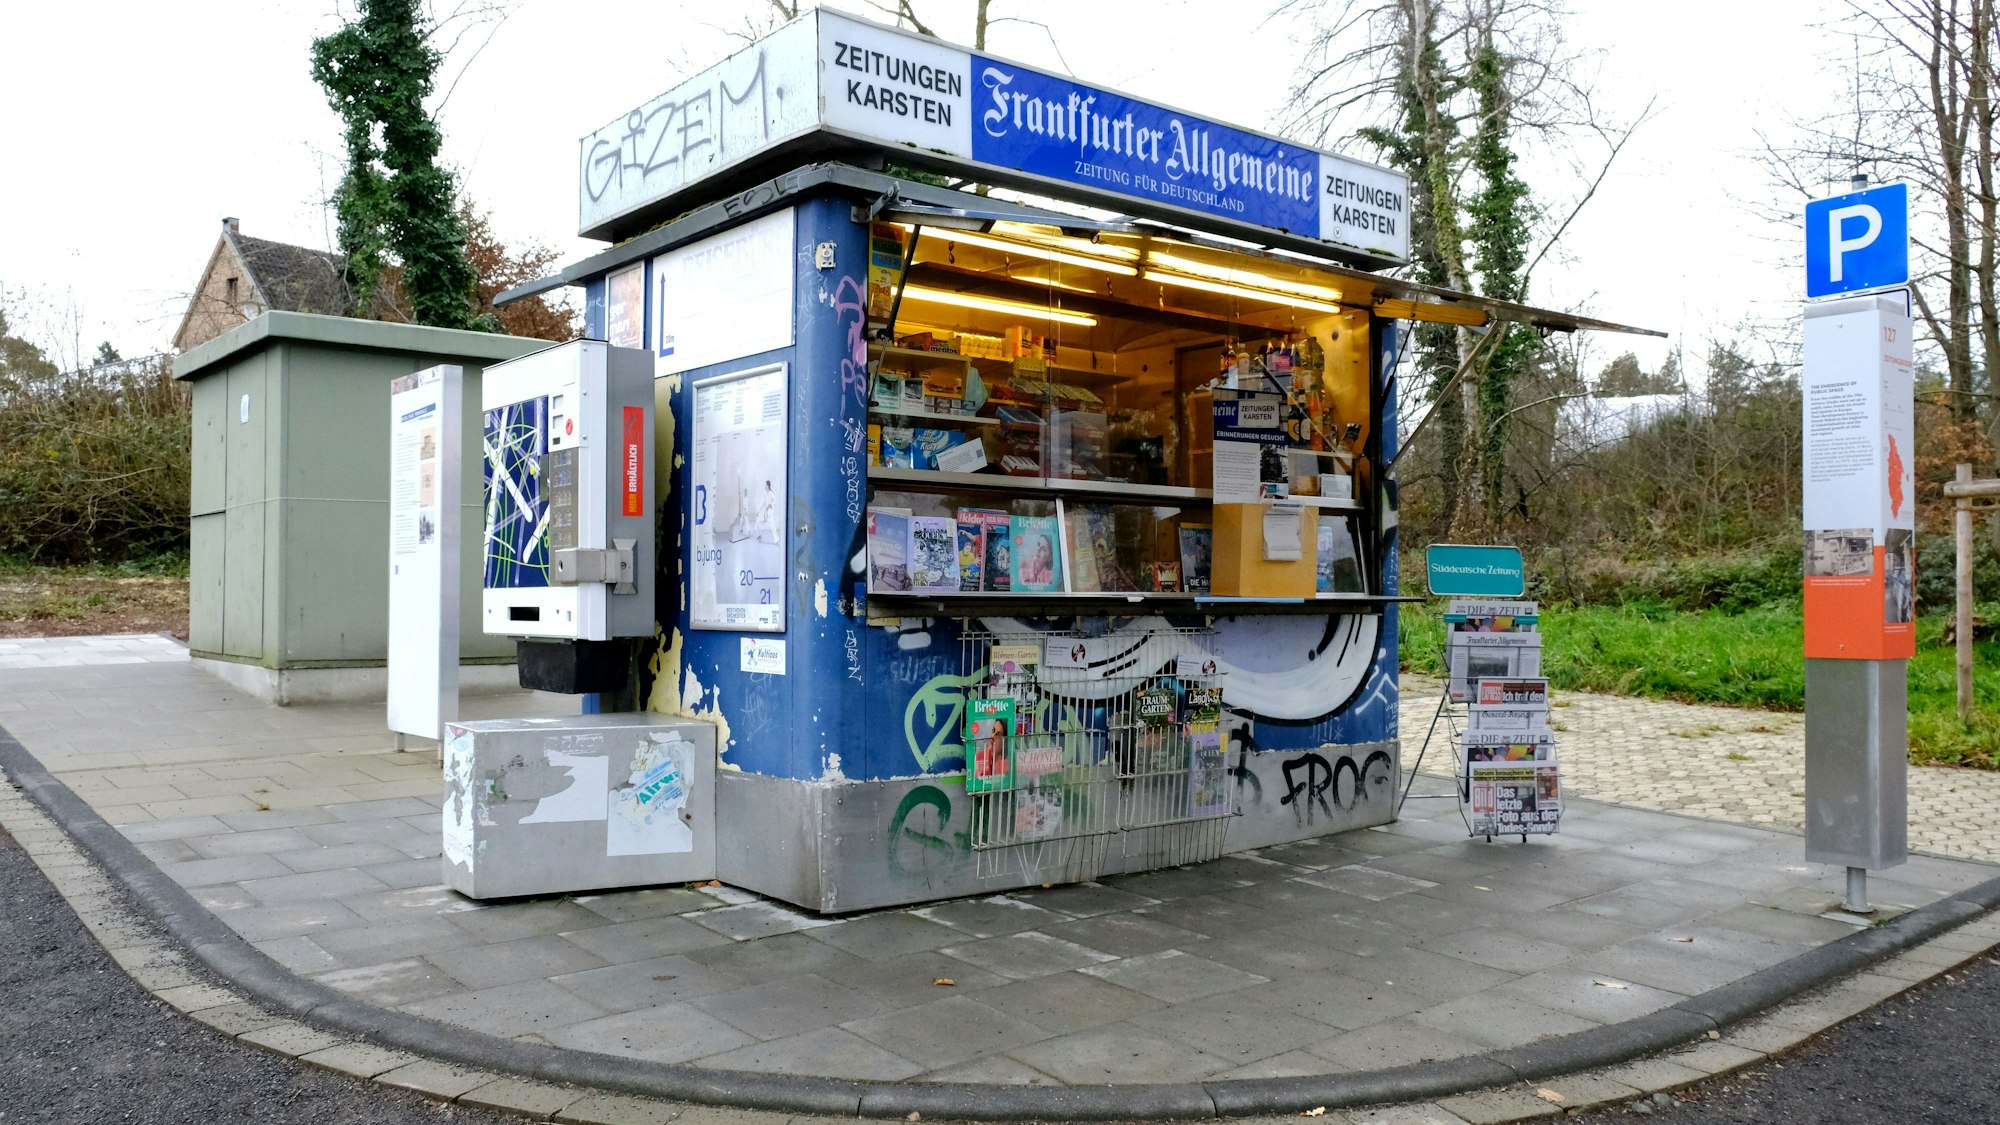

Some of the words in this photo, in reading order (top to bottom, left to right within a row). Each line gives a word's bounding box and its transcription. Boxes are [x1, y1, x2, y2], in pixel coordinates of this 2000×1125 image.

[835, 41, 962, 97] ZEITUNGEN
[847, 79, 952, 127] KARSTEN
[982, 66, 1163, 163] Frankfurter
[1165, 119, 1313, 203] Allgemeine
[1075, 160, 1129, 186] ZEITUNG
[1134, 174, 1158, 193] FÜR
[1162, 182, 1245, 213] DEUTSCHLAND
[1326, 175, 1402, 213] ZEITUNGEN
[1333, 203, 1396, 237] KARSTEN
[1829, 204, 1882, 282] P
[1884, 326, 1896, 343] 127
[930, 346, 958, 354] mentos
[1216, 431, 1259, 439] ERINNERUNGEN
[627, 444, 638, 493] ERHÄLTLICH
[628, 493, 637, 512] HIER
[696, 545, 722, 565] b.jung
[740, 569, 754, 586] 20
[1431, 563, 1487, 574] Süddeutsche
[1487, 565, 1520, 578] Zeitung
[1190, 578, 1200, 586] DIE
[760, 588, 771, 604] 21
[1468, 606, 1485, 615] DIE
[1499, 607, 1521, 615] ZEIT
[1467, 636, 1497, 644] Frankfurter
[1498, 636, 1527, 645] Allgemeine
[1018, 651, 1037, 659] Garten
[1141, 695, 1170, 705] TRAUM-
[1530, 692, 1544, 701] den
[1141, 704, 1170, 713] GARTEN
[1482, 711, 1535, 719] General-Anzeiger
[1481, 734, 1499, 743] DIE
[1513, 735, 1536, 743] ZEIT
[1474, 787, 1494, 807] Bild
[1497, 786, 1515, 798] Das
[1497, 799, 1523, 810] letzte
[1497, 811, 1519, 822] Foto
[1521, 811, 1539, 822] aus
[1541, 809, 1559, 820] der
